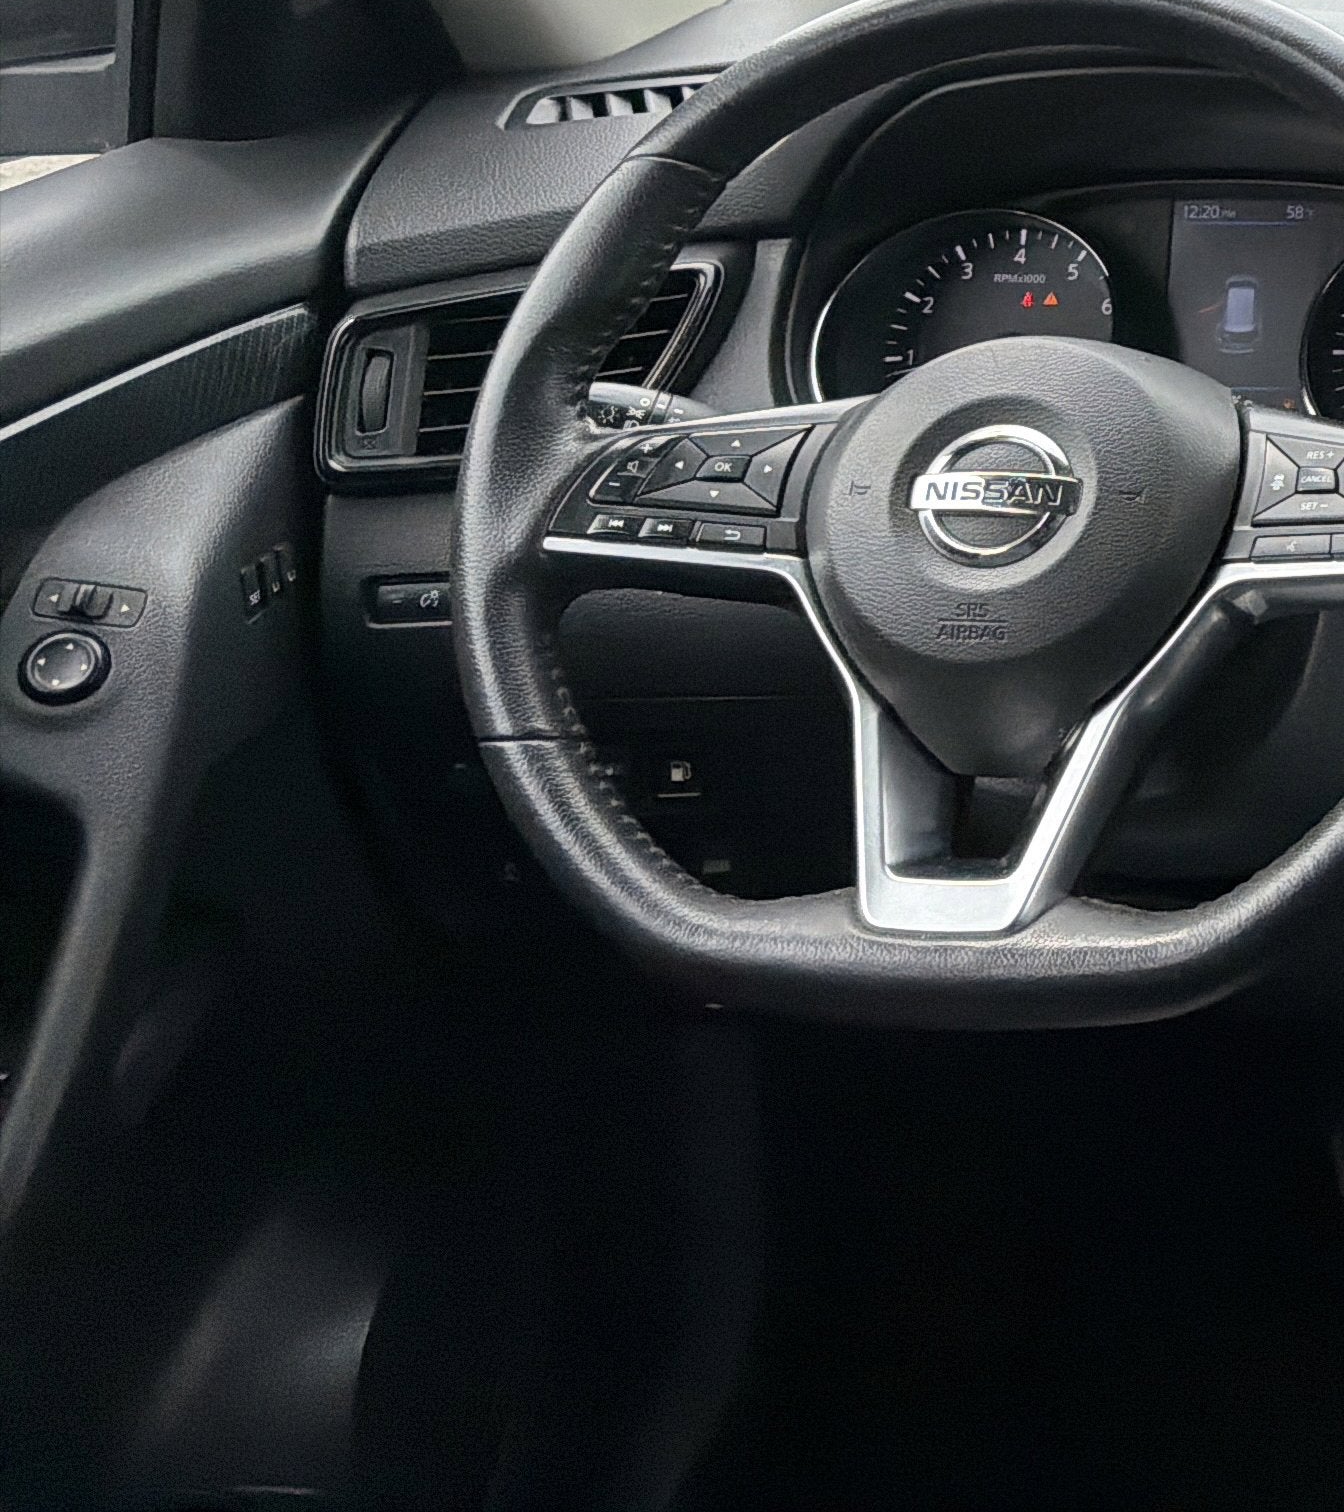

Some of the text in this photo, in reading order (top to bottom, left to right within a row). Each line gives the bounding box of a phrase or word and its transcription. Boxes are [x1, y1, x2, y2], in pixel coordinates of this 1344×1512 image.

[1012, 248, 1026, 264] 4
[960, 262, 974, 280] 3
[1067, 263, 1079, 281] 5
[922, 296, 935, 314] 2
[1101, 297, 1113, 316] 6
[906, 349, 914, 366] 1
[1306, 450, 1325, 460] RES
[714, 461, 733, 473] OK
[1300, 473, 1334, 484] CANCEL
[925, 477, 1064, 507] NISSAN
[1300, 501, 1318, 511] SET
[955, 602, 990, 618] SRS
[936, 623, 1008, 641] AIRBAG
